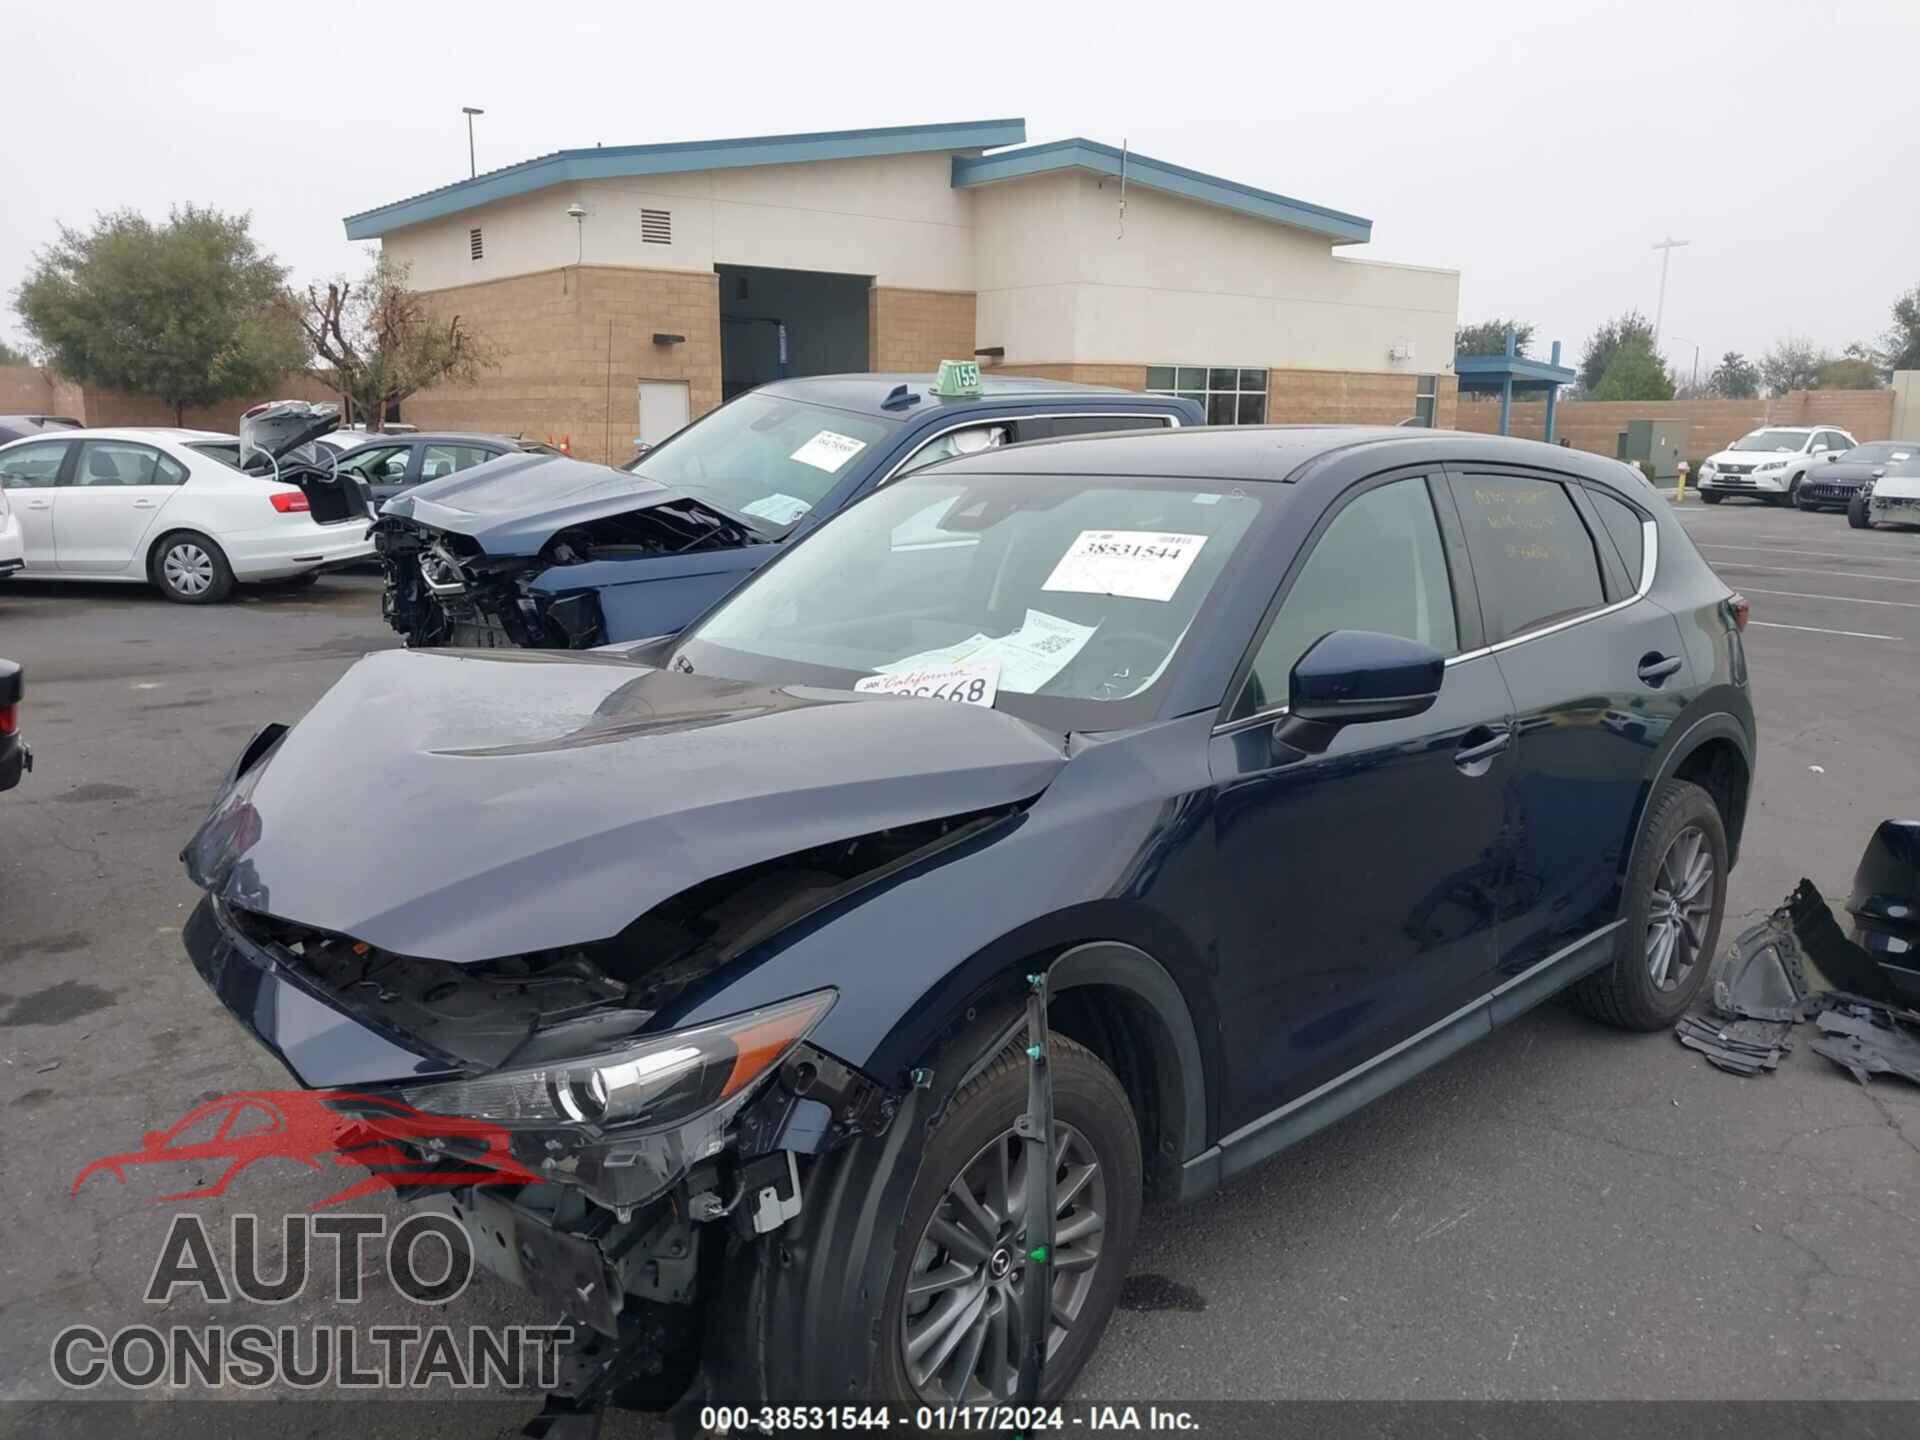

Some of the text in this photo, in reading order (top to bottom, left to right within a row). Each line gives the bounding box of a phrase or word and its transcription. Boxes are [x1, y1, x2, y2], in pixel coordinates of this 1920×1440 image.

[955, 365, 977, 386] 155
[1080, 542, 1181, 560] 38531544
[883, 668, 972, 690] California
